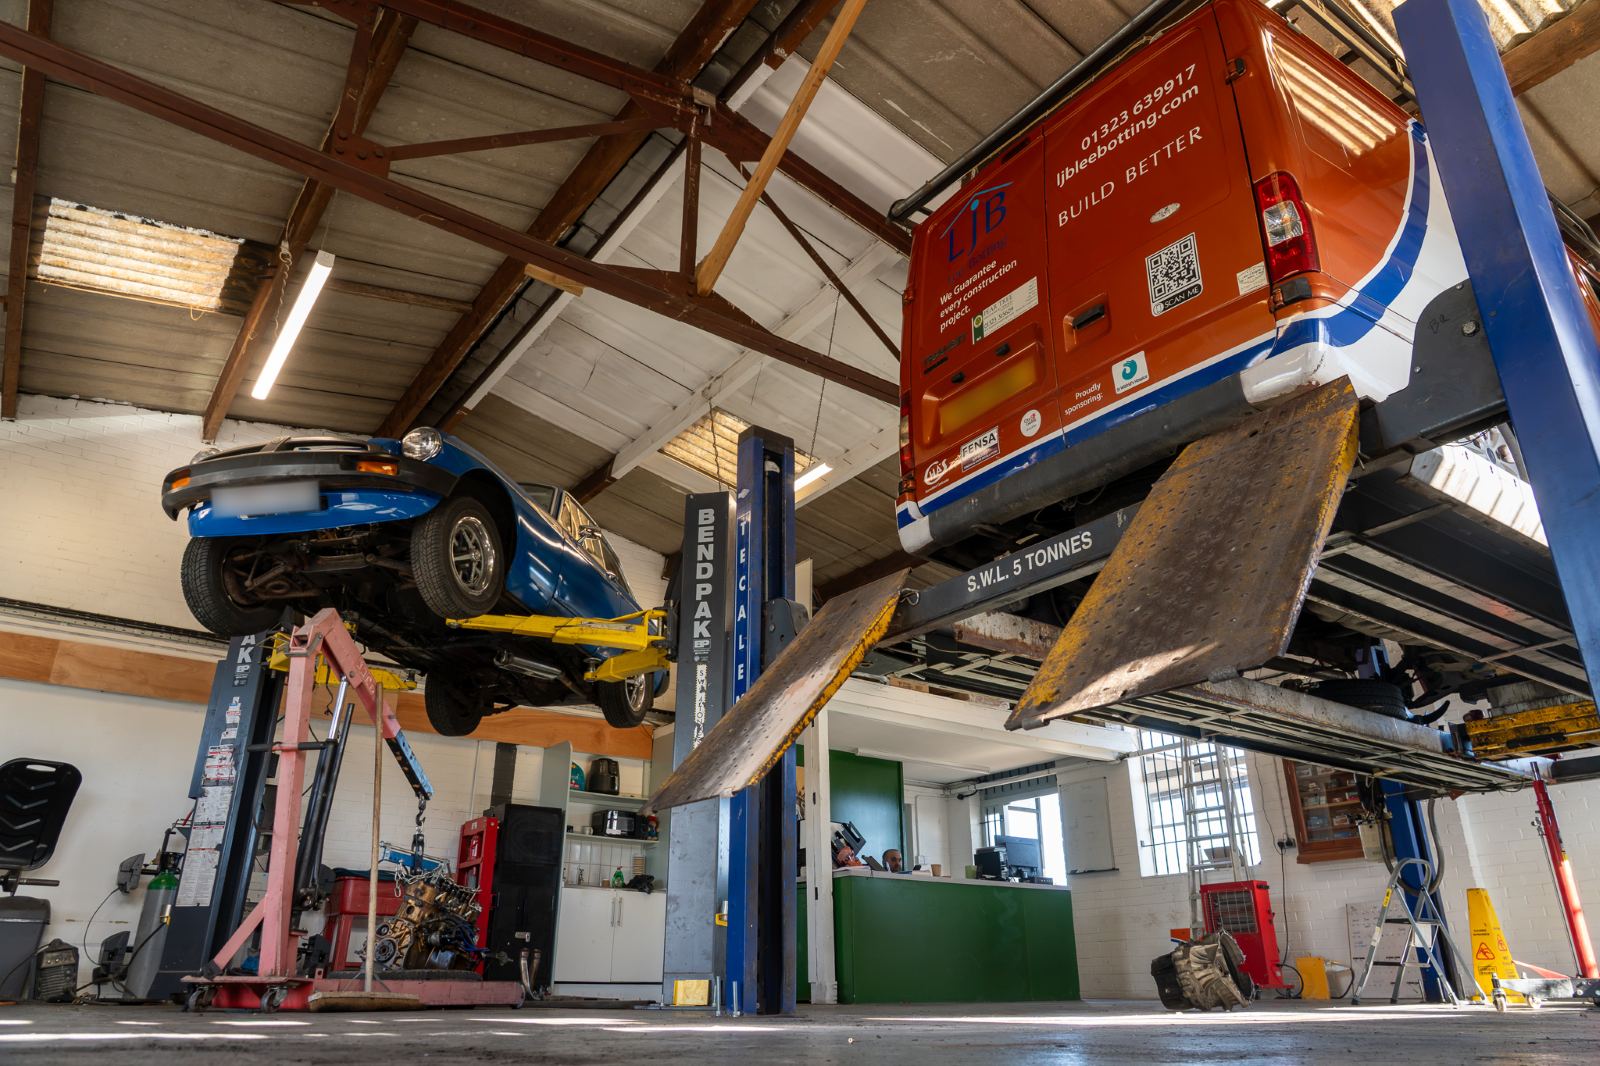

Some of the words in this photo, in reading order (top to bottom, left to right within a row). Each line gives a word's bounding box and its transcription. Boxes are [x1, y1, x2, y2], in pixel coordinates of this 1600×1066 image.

[1081, 110, 1129, 150] 01323
[1132, 63, 1196, 115] 639917
[1056, 85, 1199, 188] ljbleebotting.com
[1058, 181, 1115, 227] BUILD
[1125, 126, 1203, 184] BETTER
[940, 292, 953, 305] We
[953, 260, 997, 295] Guarantee
[940, 298, 962, 318] every
[963, 260, 1017, 302] construction
[1164, 294, 1185, 309] SCAN
[1188, 287, 1199, 297] ME
[940, 305, 971, 334] project.
[1064, 392, 1104, 416] sponsoring:
[1075, 382, 1101, 400] Proudly
[962, 432, 996, 458] FENSA
[693, 508, 715, 638] BENDPAK
[967, 564, 1010, 593] S.W.L.
[1013, 558, 1022, 576] 5
[1025, 531, 1093, 570] TONNES
